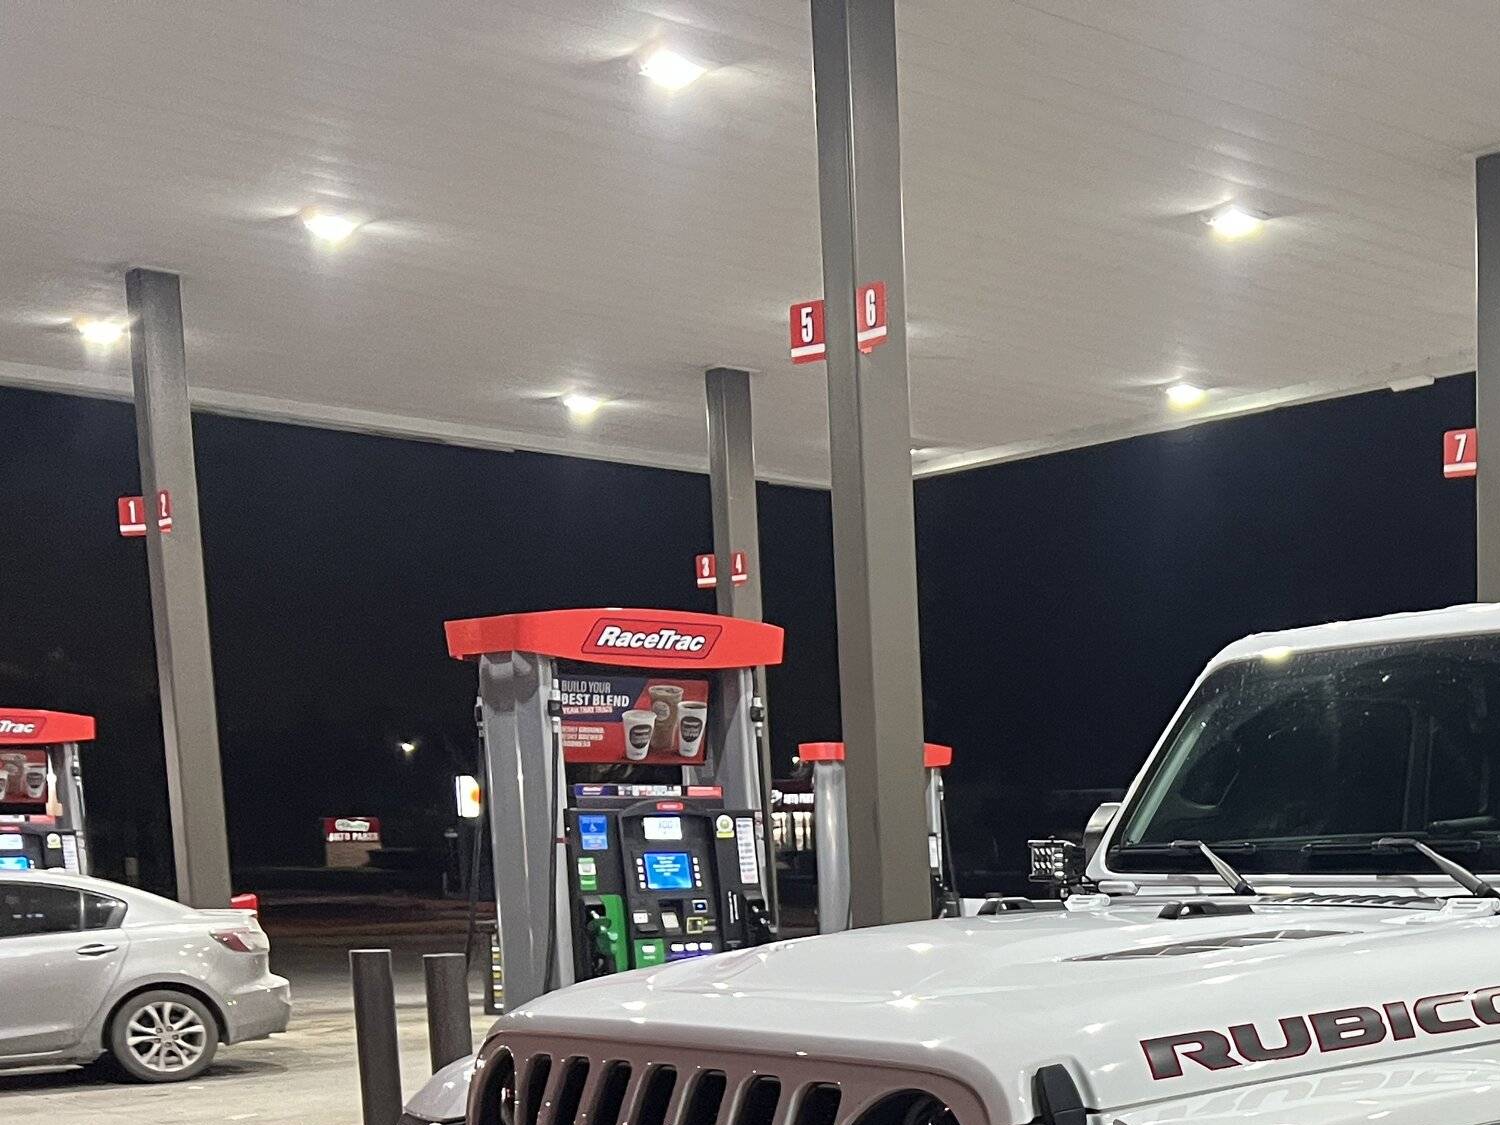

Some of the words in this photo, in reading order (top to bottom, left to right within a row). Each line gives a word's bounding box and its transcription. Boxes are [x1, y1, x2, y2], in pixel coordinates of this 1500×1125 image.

[865, 288, 876, 327] 6
[800, 306, 813, 343] 5
[1454, 432, 1467, 462] 7
[128, 500, 136, 524] 1
[596, 625, 706, 652] RaceTrac
[561, 680, 587, 693] BUILD
[588, 681, 611, 694] YOUR
[561, 693, 590, 706] BEST
[592, 694, 630, 708] BLEND
